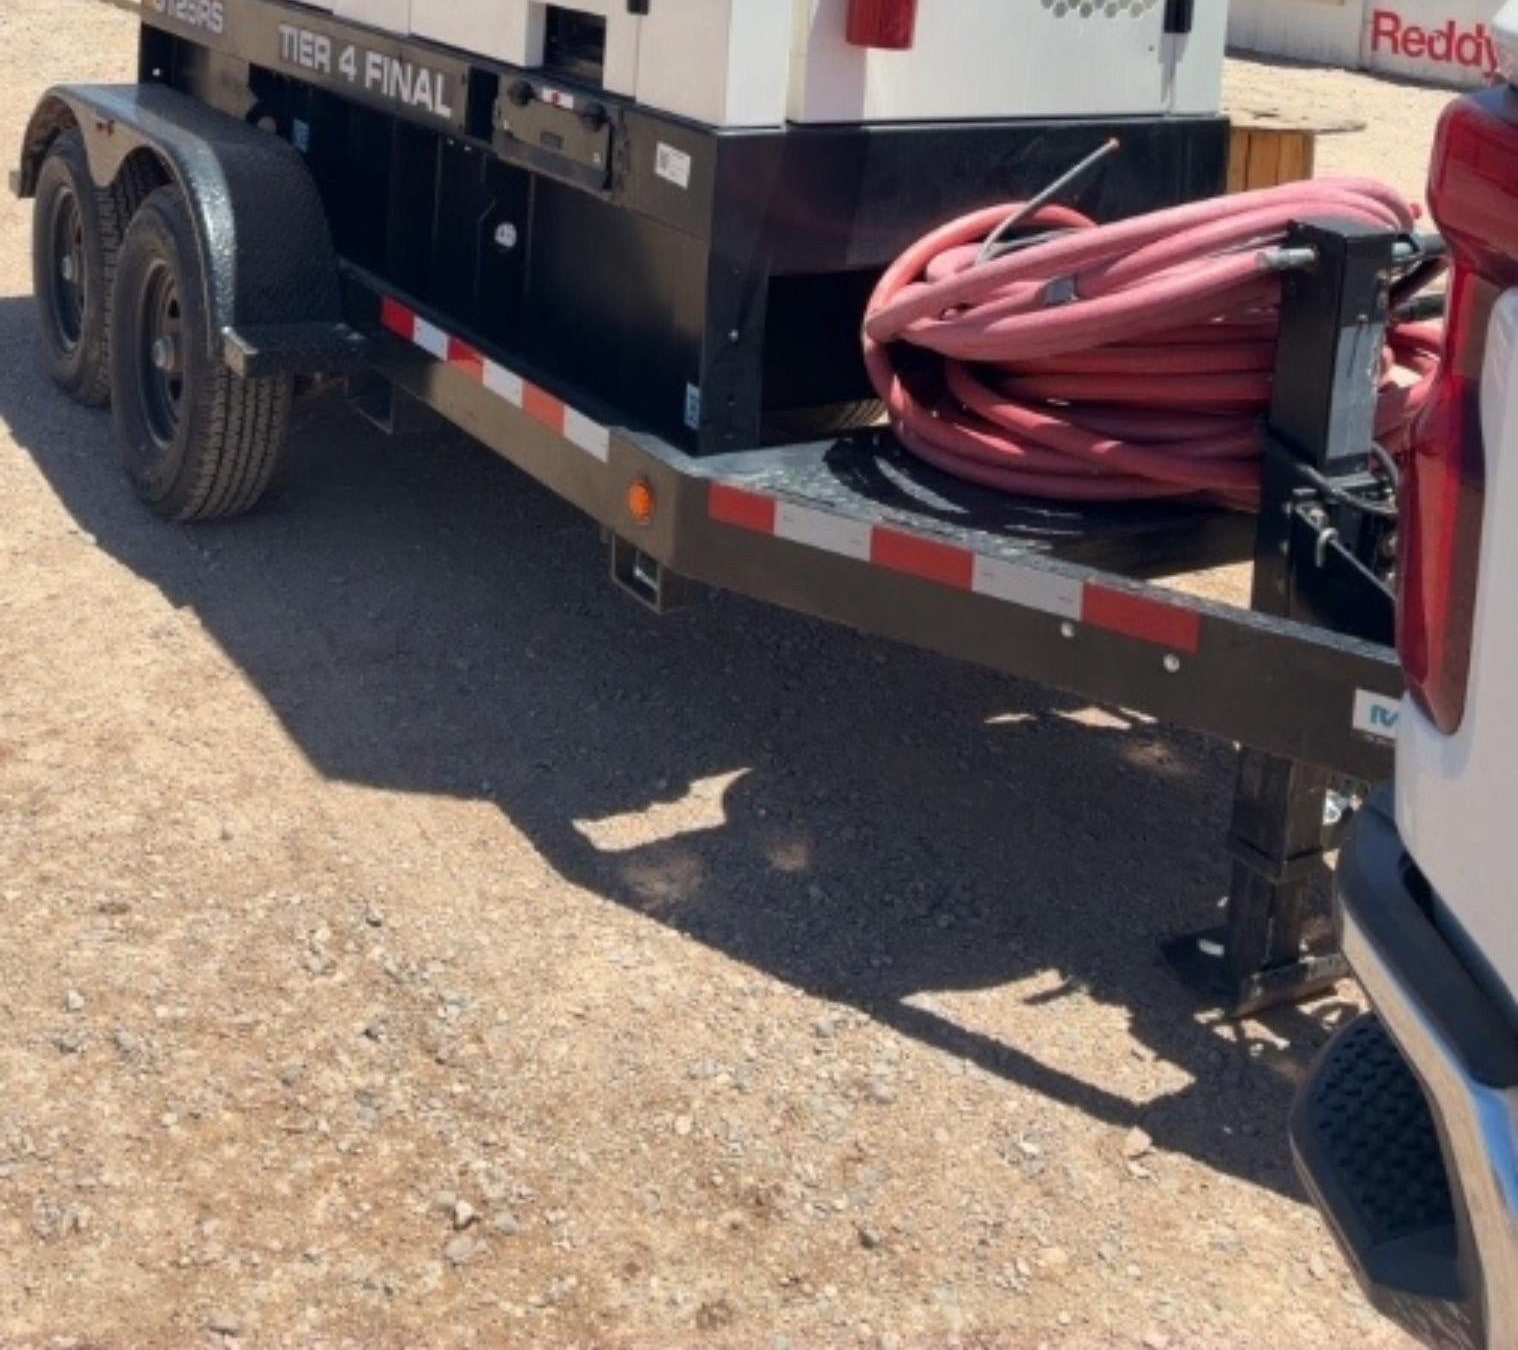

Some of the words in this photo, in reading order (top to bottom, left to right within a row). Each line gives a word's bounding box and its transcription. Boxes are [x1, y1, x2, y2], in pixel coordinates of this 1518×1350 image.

[277, 23, 331, 74] TIER
[337, 44, 358, 83] 4
[364, 50, 453, 119] FINAL
